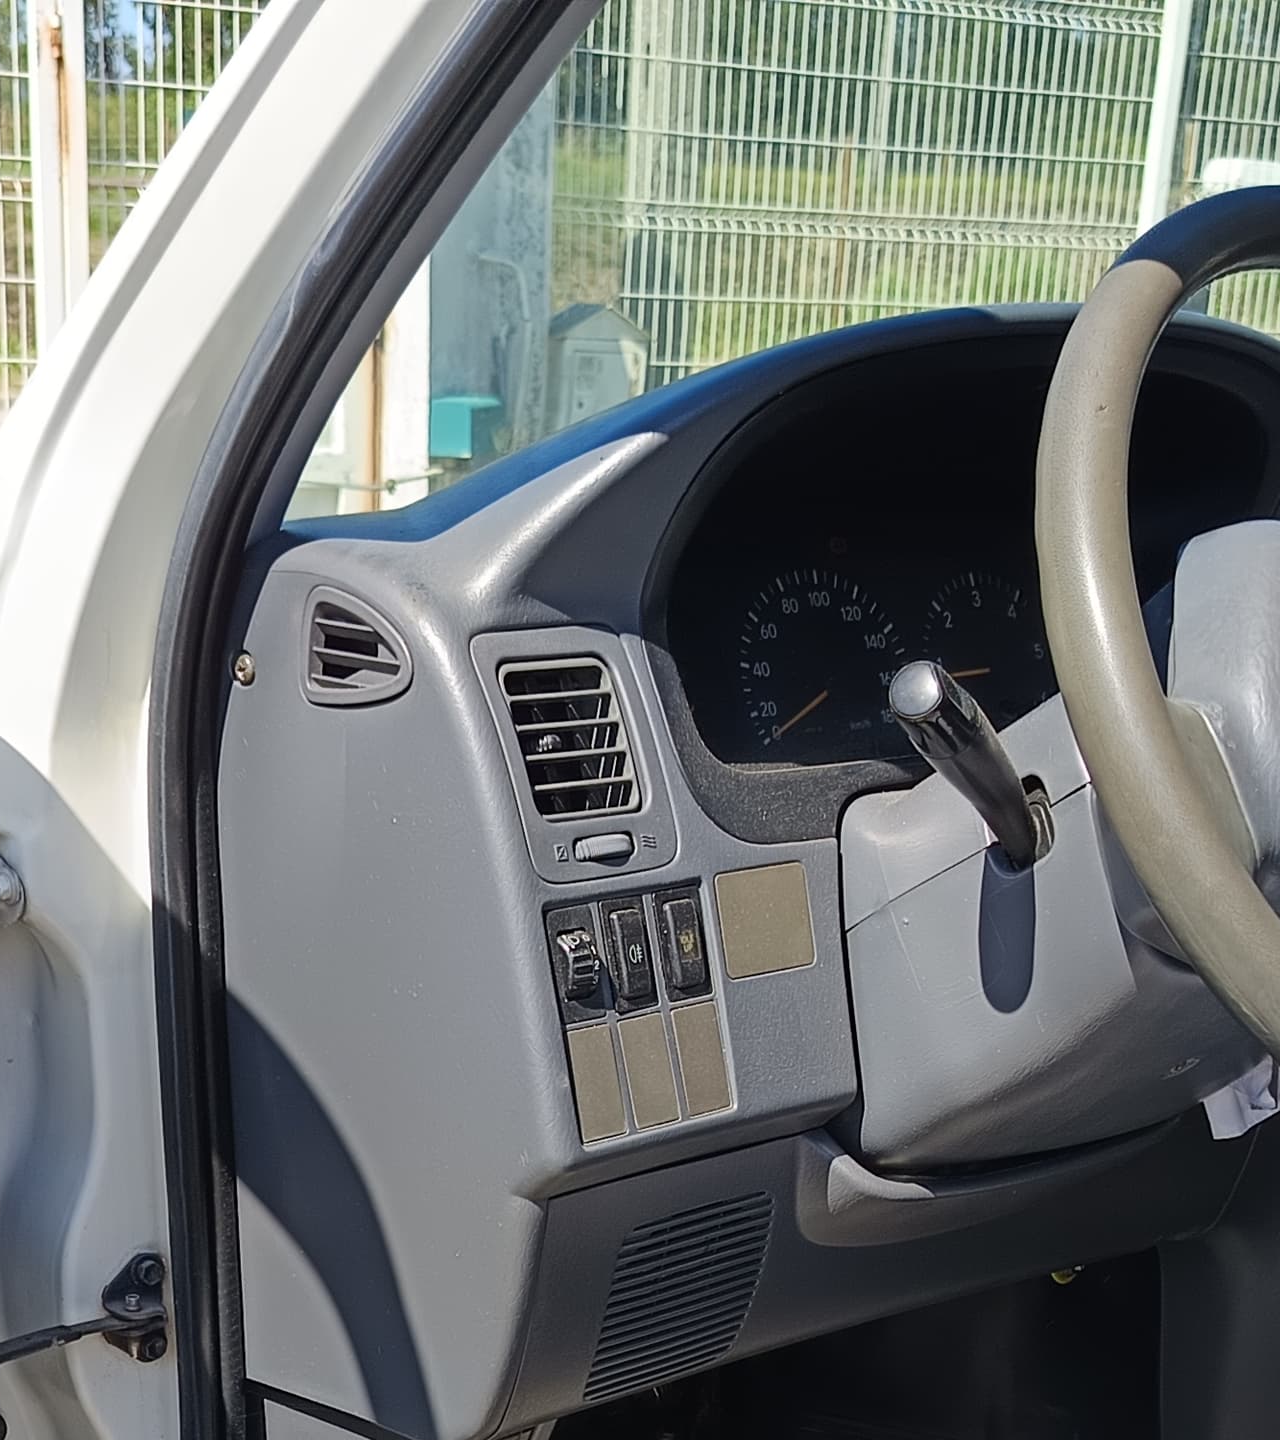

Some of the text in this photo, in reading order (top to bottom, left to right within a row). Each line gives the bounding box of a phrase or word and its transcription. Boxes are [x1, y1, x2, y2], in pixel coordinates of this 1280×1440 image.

[782, 598, 799, 614] 80
[808, 591, 830, 607] 100
[971, 591, 982, 608] 3
[841, 606, 862, 622] 120
[1007, 603, 1018, 619] 4
[943, 611, 953, 628] 2
[760, 623, 777, 640] 60
[864, 633, 886, 649] 140
[753, 661, 771, 678] 40
[759, 700, 777, 718] 20
[594, 960, 600, 970] 2
